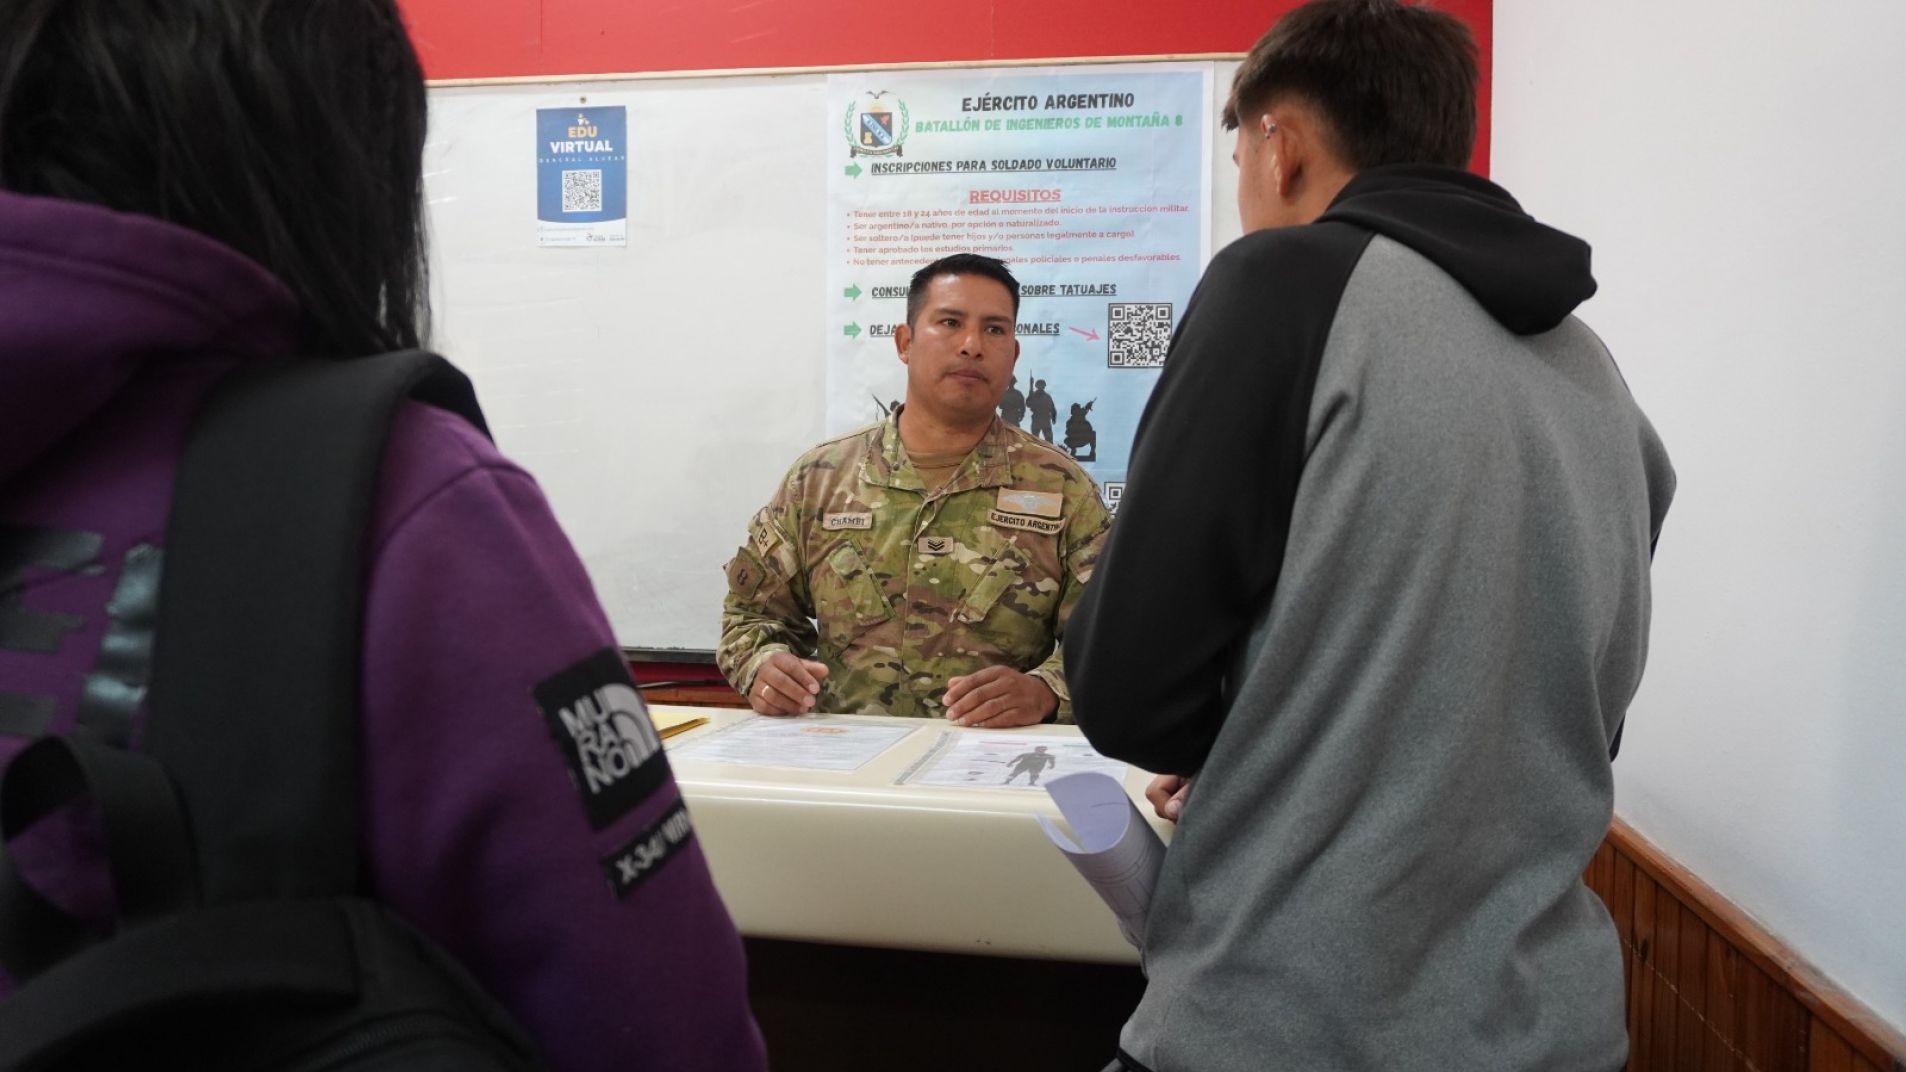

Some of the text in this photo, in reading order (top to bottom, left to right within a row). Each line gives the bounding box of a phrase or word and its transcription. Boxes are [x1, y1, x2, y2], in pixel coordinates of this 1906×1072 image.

[962, 93, 1134, 111] EJÉRCITO ARGENTINO
[915, 112, 1183, 133] BATALLÓN DE INGENIEROS DE MONTAÑA 8
[568, 126, 597, 138] EDU
[550, 140, 613, 154] VIRTUAL
[871, 156, 1117, 175] INSCRIPCIONES PARA SOLDADO VOLUNTARIO
[970, 190, 1061, 203] REQUISITOS
[853, 209, 877, 218] Tener
[878, 209, 901, 218] entre
[914, 210, 919, 219] y
[954, 208, 965, 216] de
[968, 207, 989, 216] edad
[991, 207, 999, 215] al
[1001, 206, 1043, 215] momento
[1045, 206, 1059, 214] del
[1060, 205, 1083, 214] inicio
[1085, 205, 1096, 213] de
[1098, 205, 1107, 213] la
[853, 222, 867, 230] Ser
[869, 222, 919, 232] argentino/a
[951, 221, 965, 230] por
[853, 234, 867, 242] Ser
[942, 232, 964, 241] tener
[967, 231, 986, 242] hijos
[1006, 231, 1045, 242] personas
[1047, 230, 1096, 241] legalmente
[1098, 231, 1104, 239] a
[853, 245, 876, 254] Tener
[878, 244, 919, 255] aprobado
[920, 244, 934, 253] los
[935, 243, 971, 253] estudios
[853, 258, 865, 266] No
[866, 257, 889, 266] tener
[1030, 254, 1072, 264] policiales
[1082, 252, 1116, 264] penales
[1021, 284, 1056, 296] SOBRE
[1059, 283, 1117, 296] TATUAJES
[1015, 322, 1060, 335] ONALES
